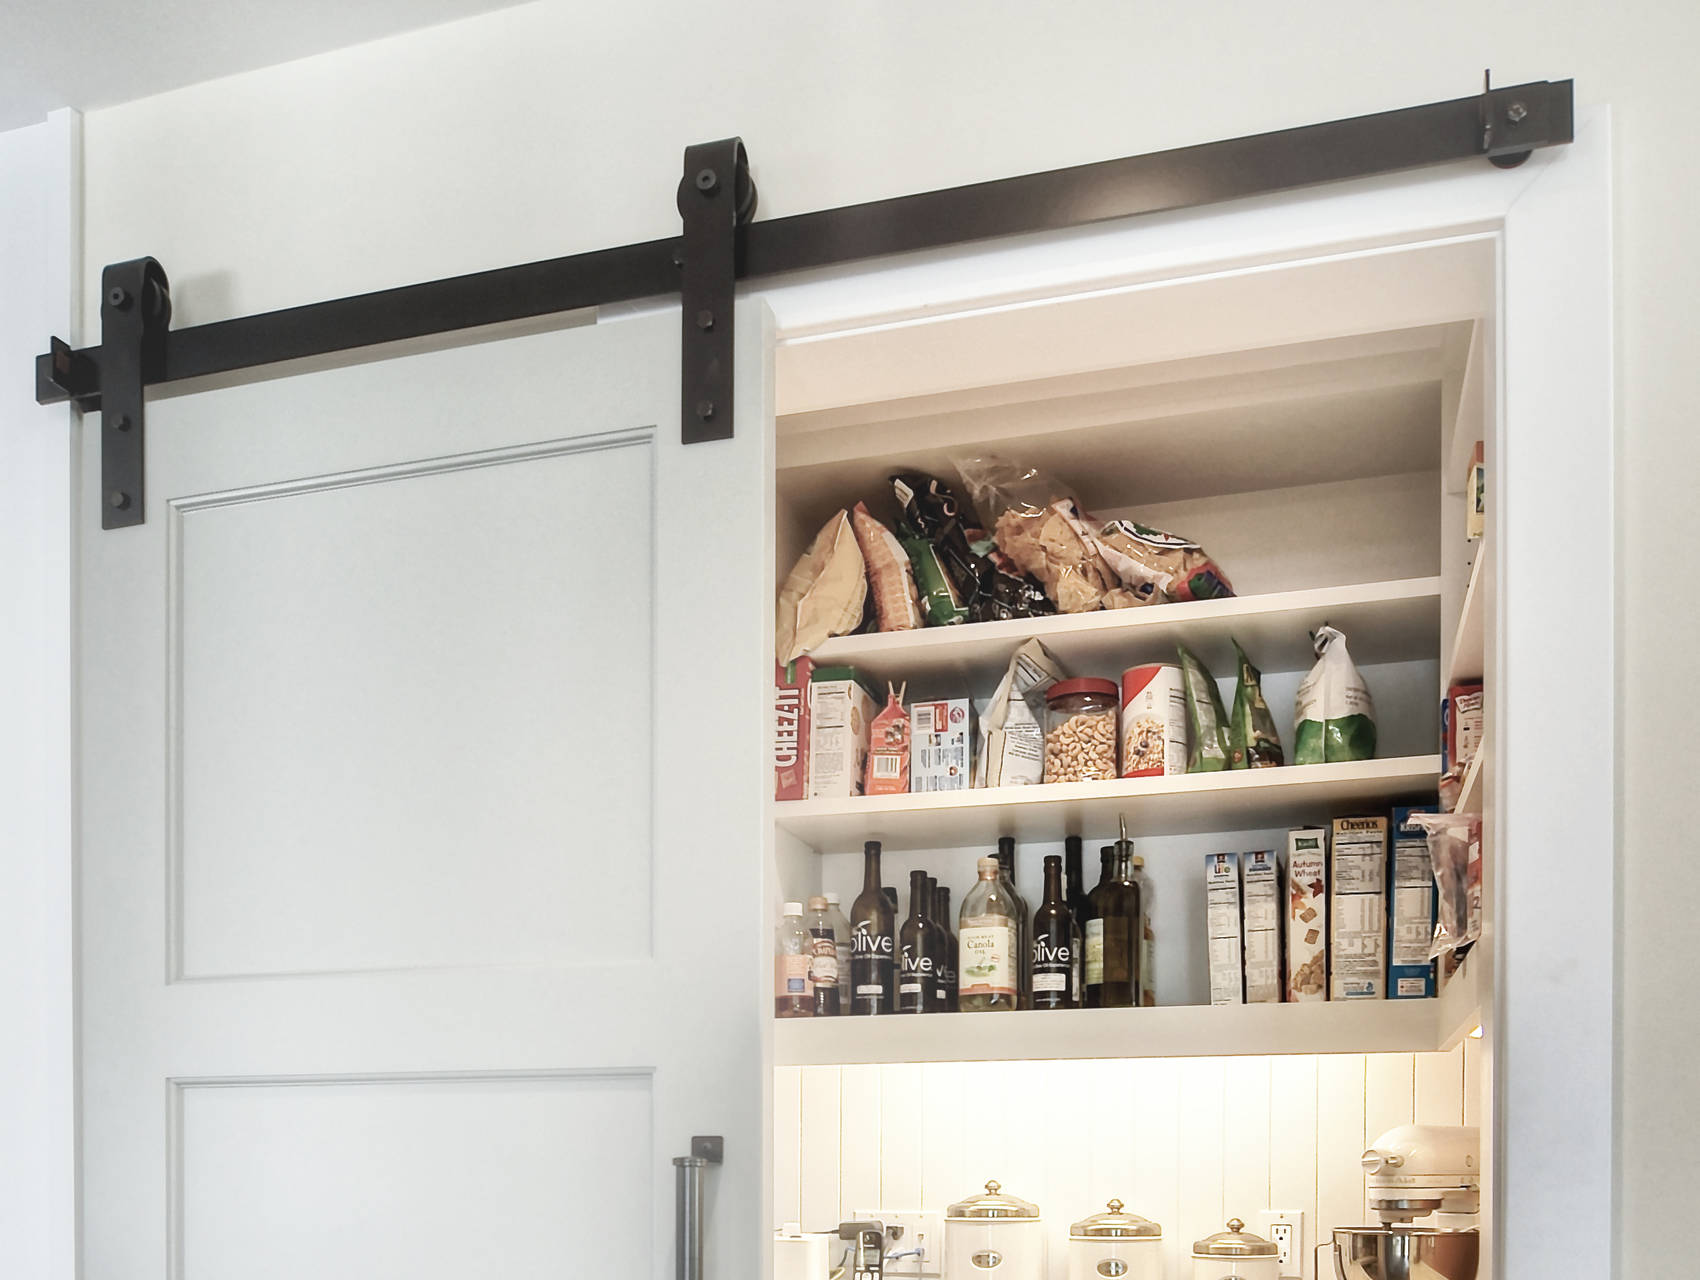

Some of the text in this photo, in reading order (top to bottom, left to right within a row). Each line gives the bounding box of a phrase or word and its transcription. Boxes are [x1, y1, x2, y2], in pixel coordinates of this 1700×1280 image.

[1340, 820, 1377, 830] Cheerios
[967, 939, 995, 949] Canola
[901, 952, 933, 972] live
